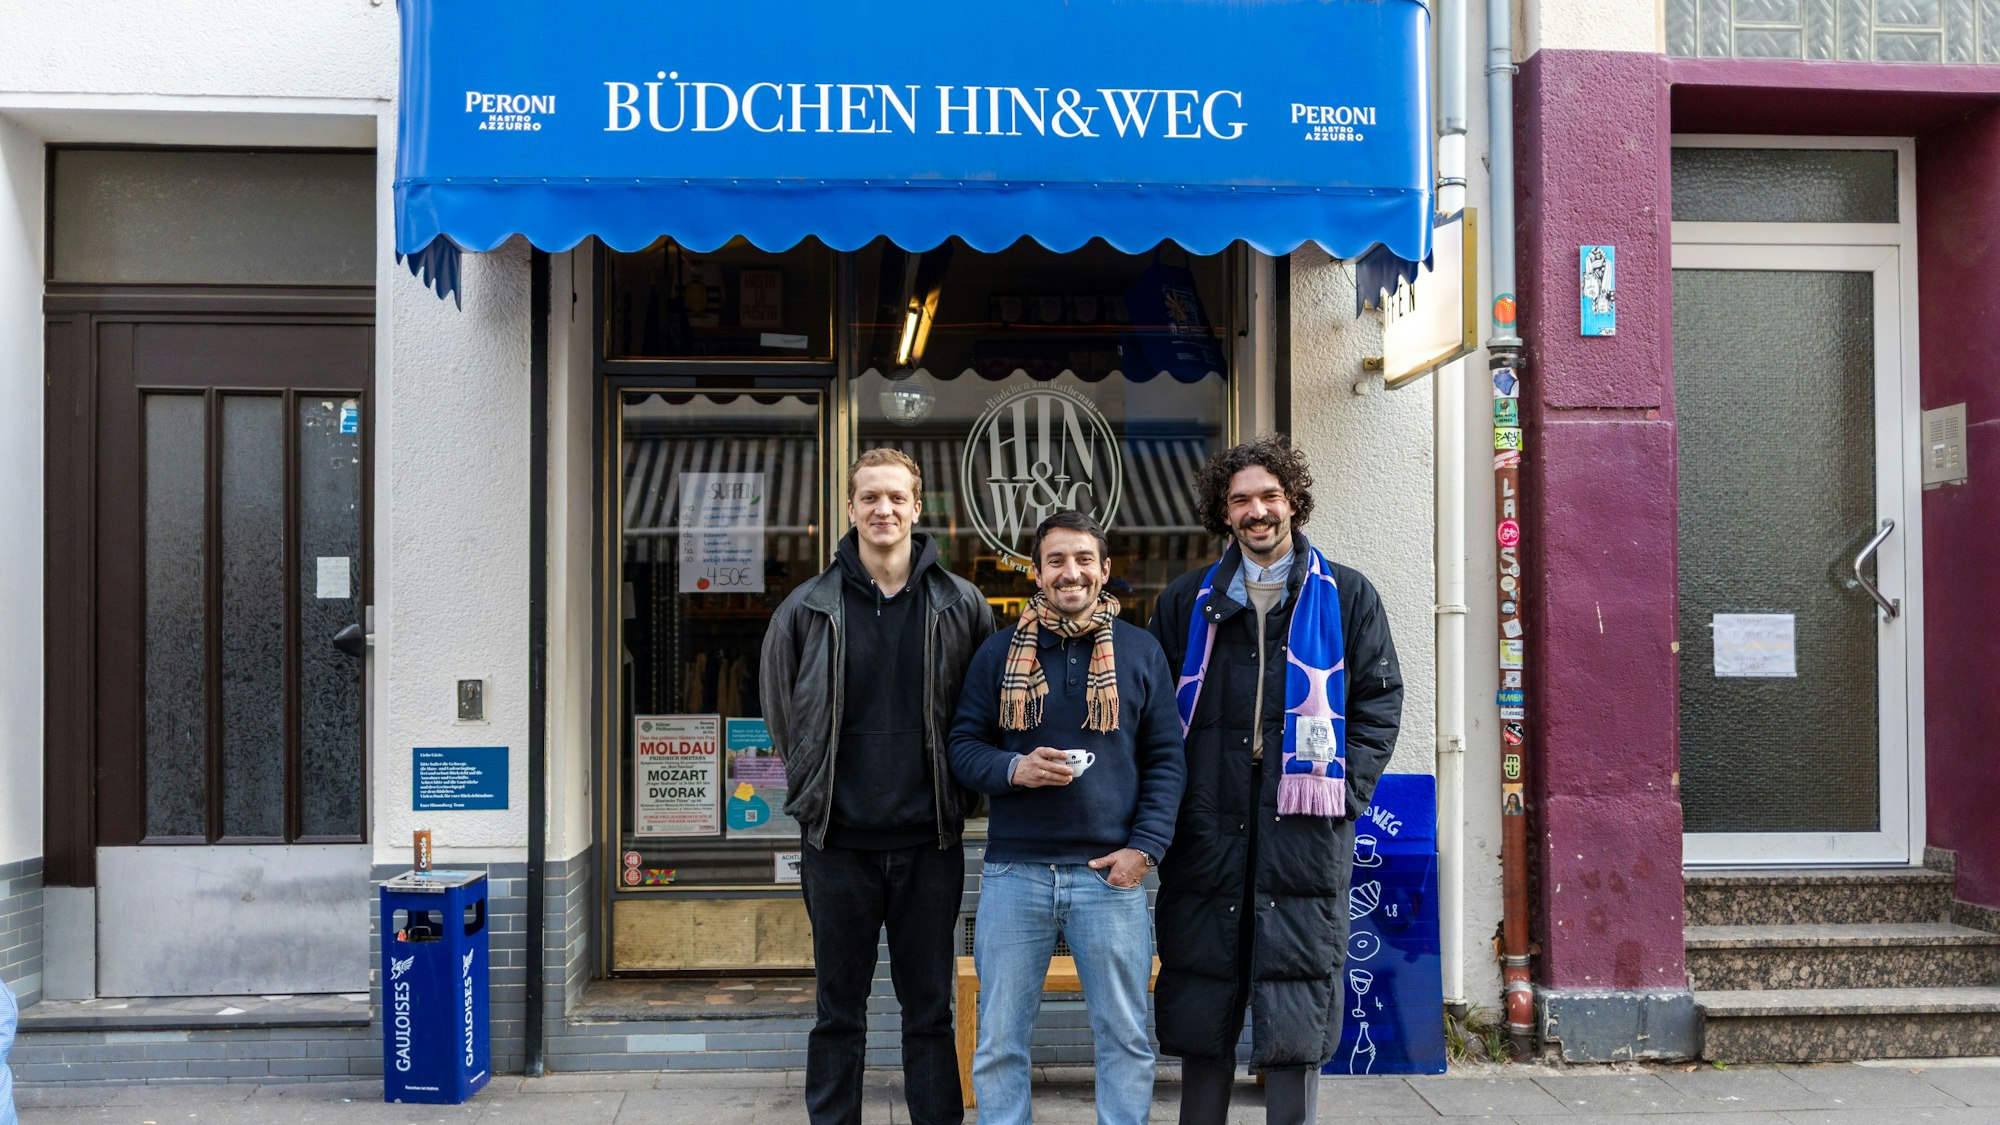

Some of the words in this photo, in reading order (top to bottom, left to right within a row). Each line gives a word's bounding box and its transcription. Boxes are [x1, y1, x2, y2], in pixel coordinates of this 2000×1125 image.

[464, 91, 556, 115] PERONI
[603, 70, 921, 135] BÜDCHEN
[935, 86, 1248, 141] HIN&WEG
[488, 115, 532, 123] NASTRO
[1291, 103, 1377, 126] PERONI
[478, 122, 542, 131] AZZURRO
[1305, 133, 1364, 142] AZZURRO
[986, 395, 1099, 480] HIN
[1001, 554, 1034, 575] Kwart
[640, 741, 715, 755] MOLDAU
[648, 770, 708, 781] MOZART
[649, 787, 707, 798] DVORAK
[1372, 805, 1403, 837] WEG
[394, 981, 411, 1072] GAULOISES
[464, 976, 474, 1067] GAULOISES
